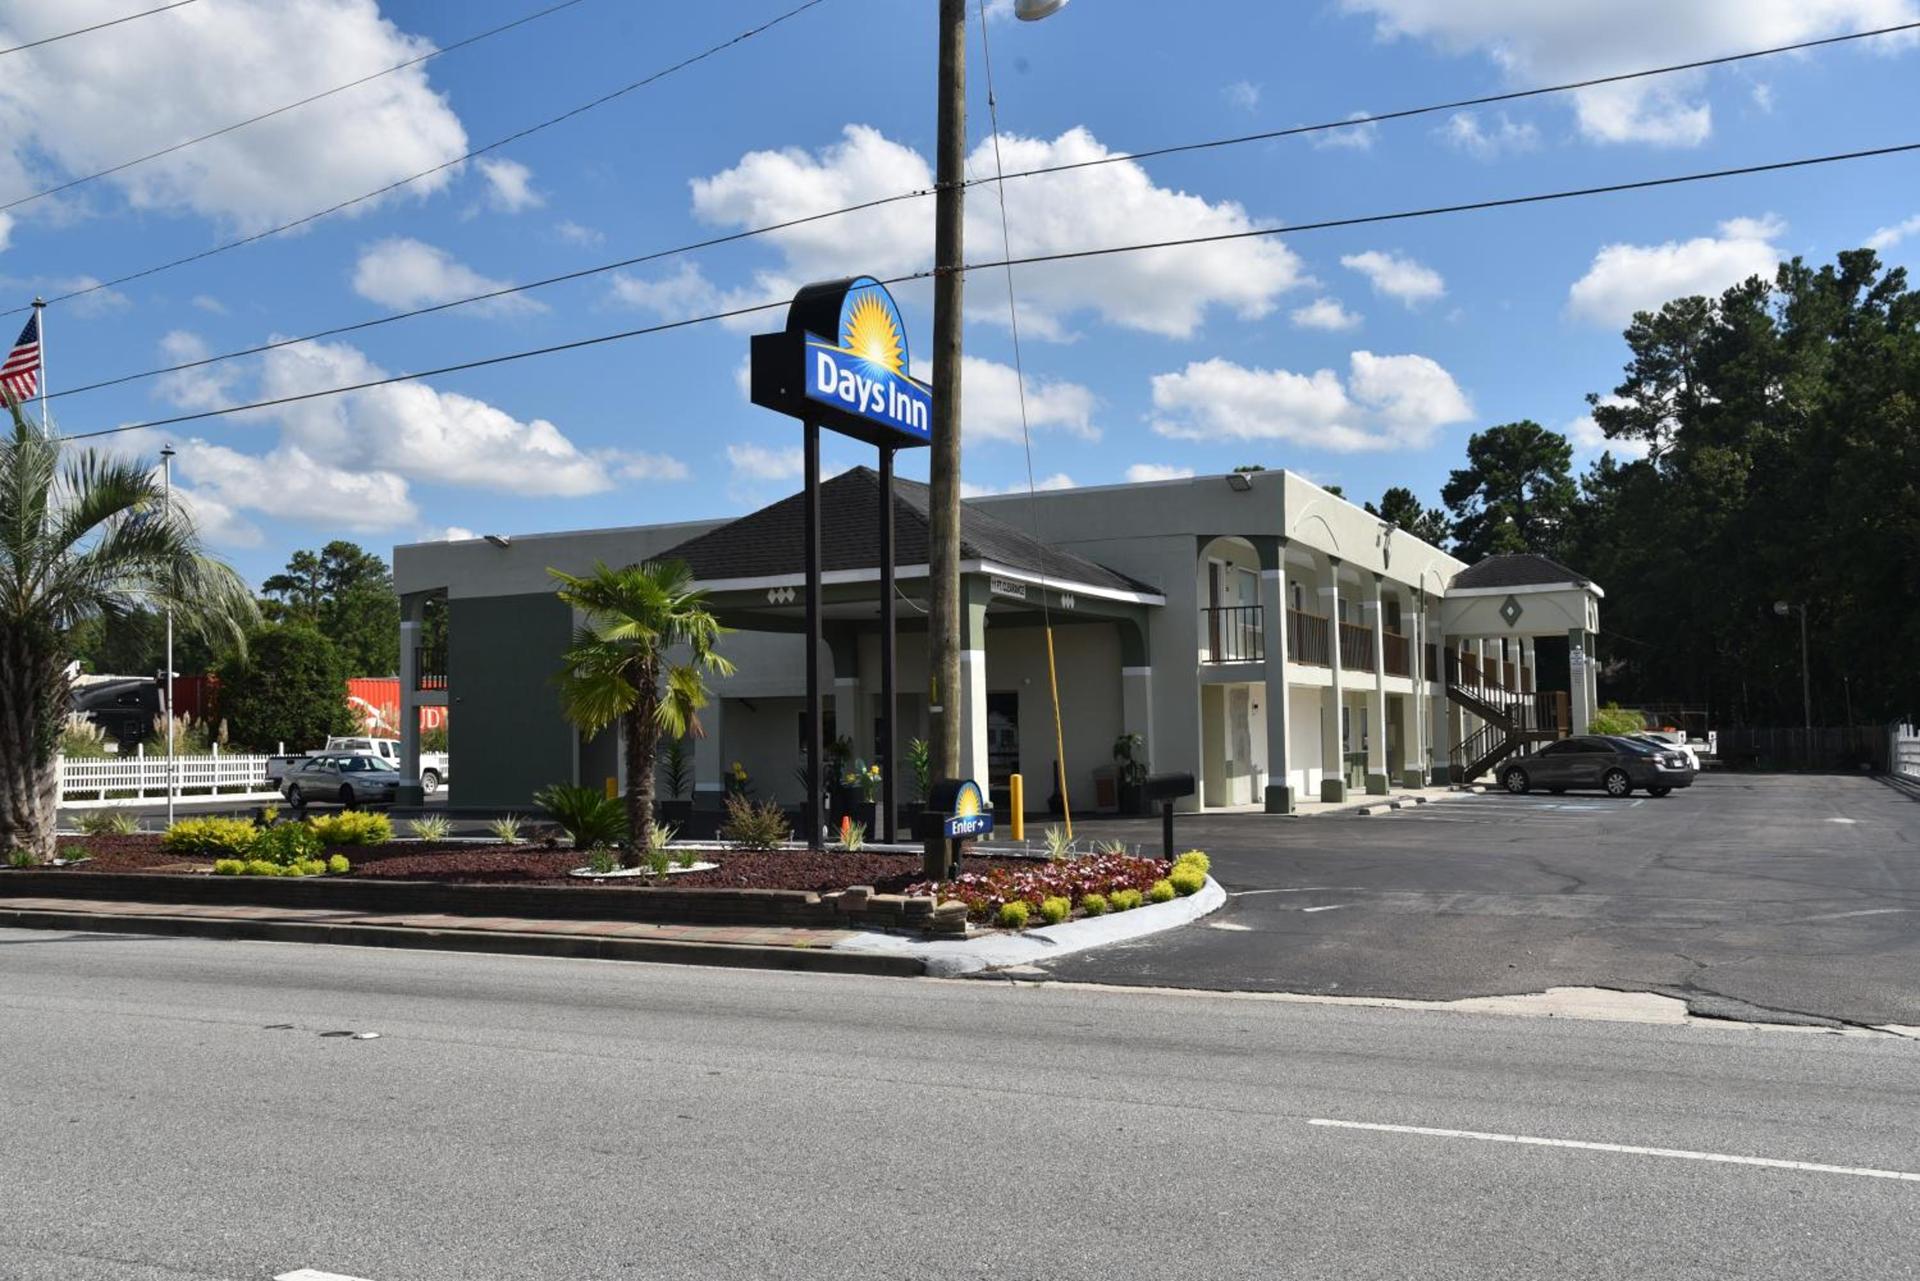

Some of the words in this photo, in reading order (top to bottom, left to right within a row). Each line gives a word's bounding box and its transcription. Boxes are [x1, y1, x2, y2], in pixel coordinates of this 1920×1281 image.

[817, 351, 885, 413] Days
[889, 381, 928, 431] Inn
[1003, 582, 1025, 596] CLEARANCE
[952, 820, 977, 835] Enter
